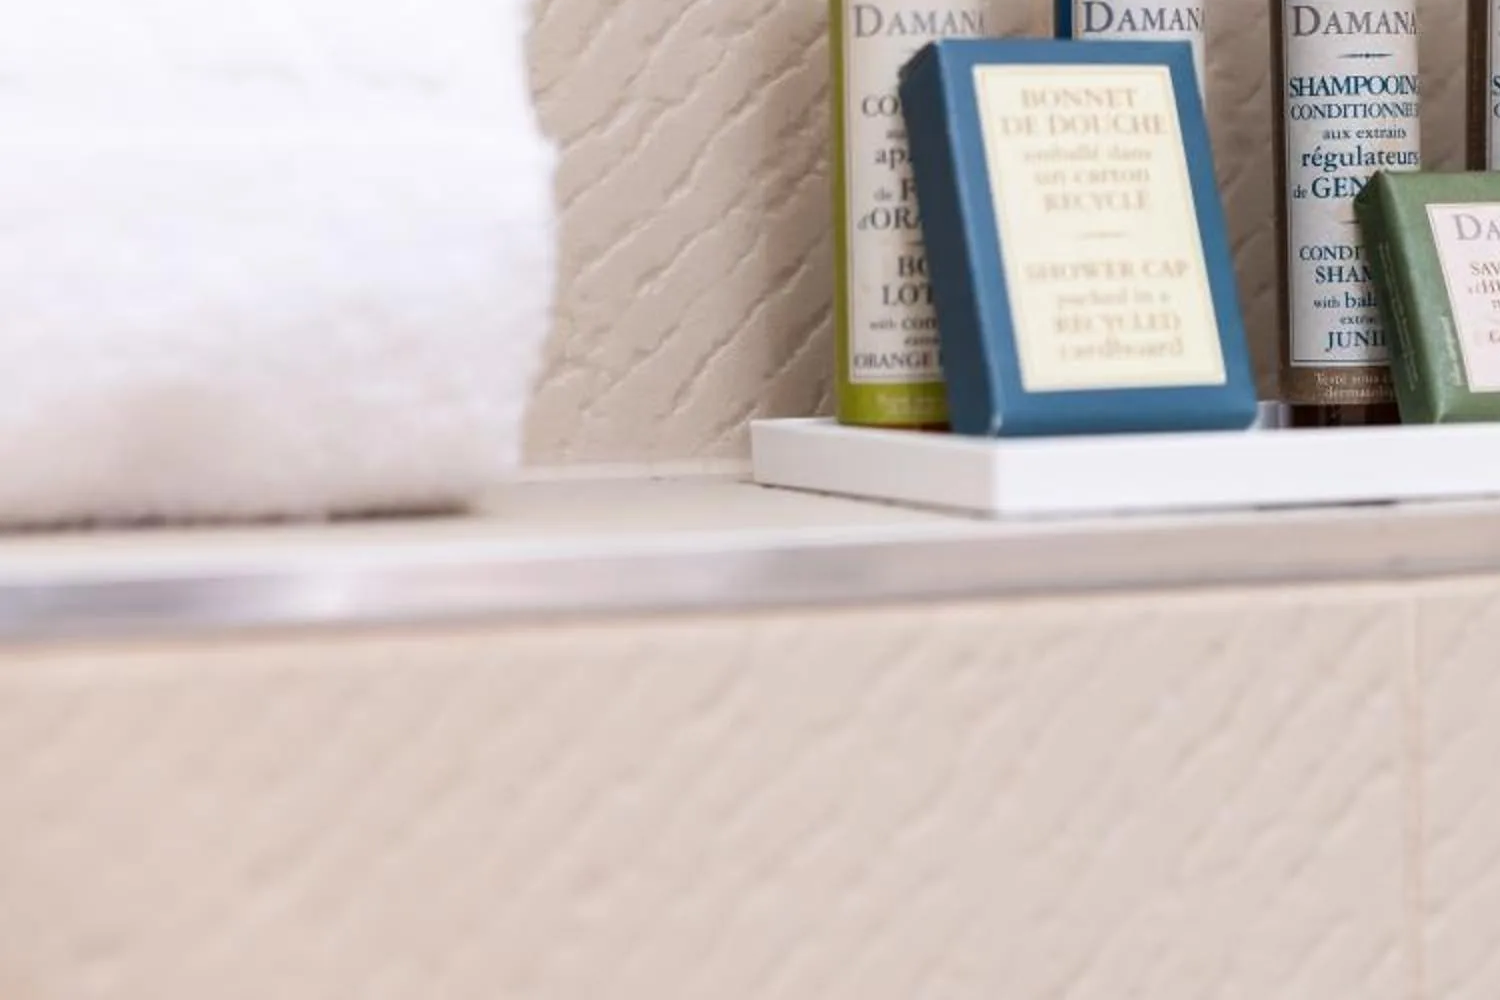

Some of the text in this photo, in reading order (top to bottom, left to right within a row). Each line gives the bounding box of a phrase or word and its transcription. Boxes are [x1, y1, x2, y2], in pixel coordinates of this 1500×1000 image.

[853, 3, 985, 38] DAMAN
[1083, 0, 1204, 33] DAMAN
[1289, 75, 1418, 97] SHAMPOOIN
[1290, 102, 1419, 120] CONDITIONNE
[1322, 125, 1407, 140] aux extraits
[1302, 145, 1419, 172] régulateurs
[1293, 175, 1369, 199] de GEN
[1315, 265, 1372, 284] SHAM
[1314, 296, 1340, 309] with
